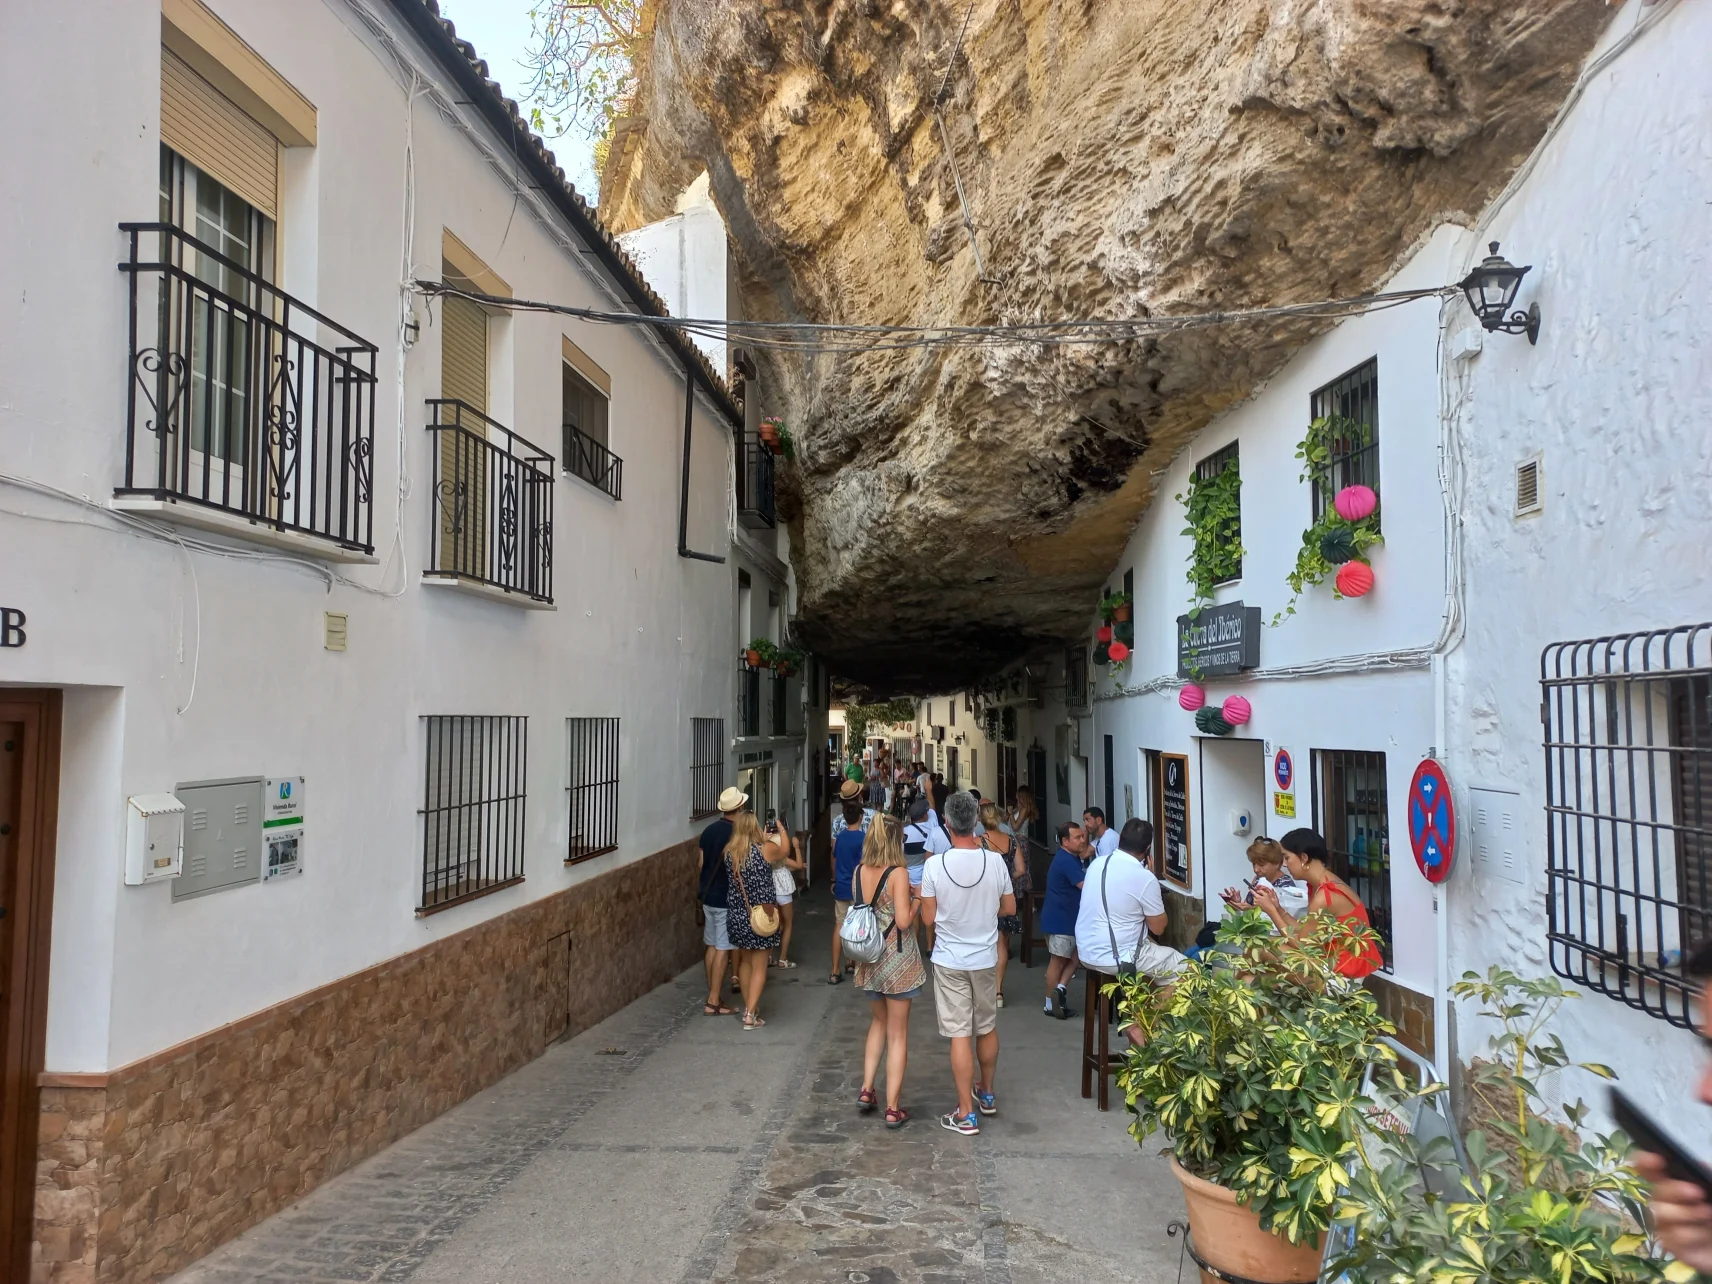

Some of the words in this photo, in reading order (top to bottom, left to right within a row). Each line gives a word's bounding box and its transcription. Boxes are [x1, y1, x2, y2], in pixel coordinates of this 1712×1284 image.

[0, 607, 26, 648] B
[1208, 618, 1217, 643] del
[1218, 614, 1241, 642] Ibérico
[1229, 650, 1240, 663] TIERRA
[1265, 742, 1270, 754] 8
